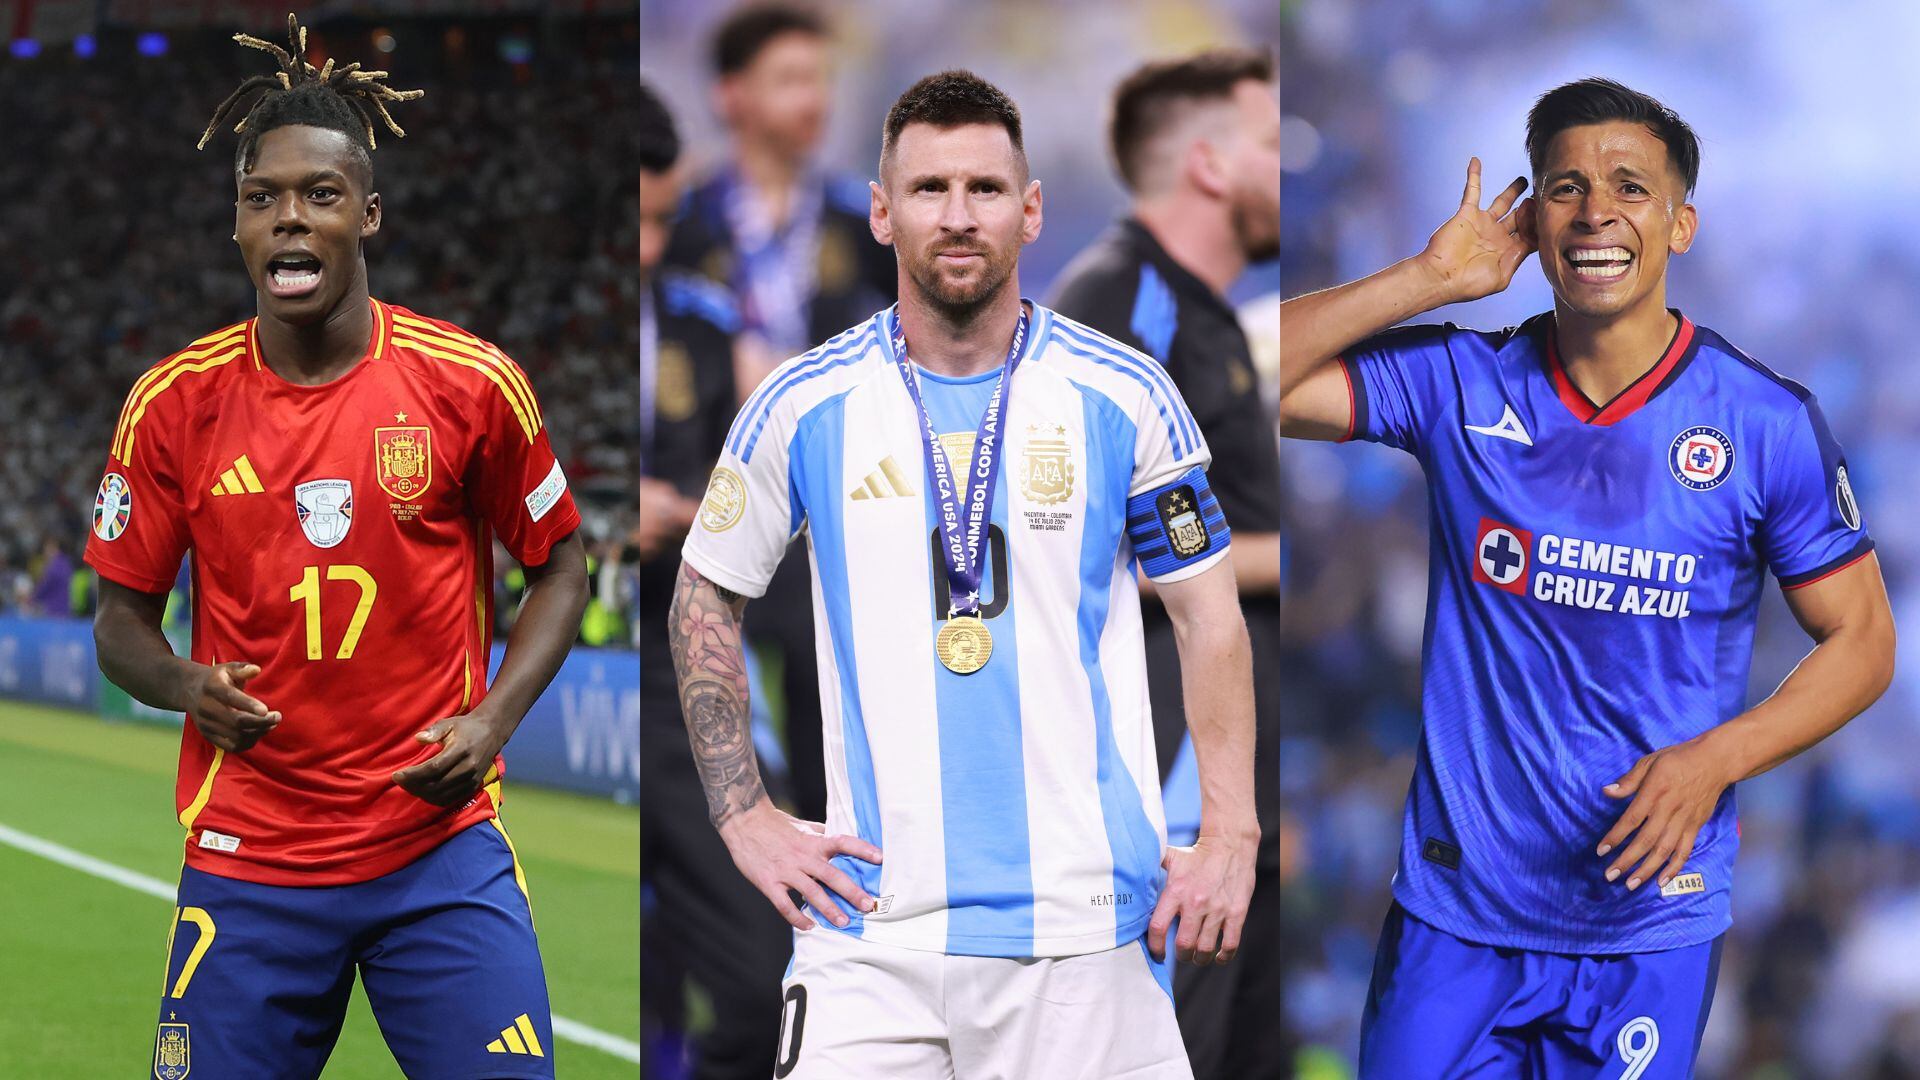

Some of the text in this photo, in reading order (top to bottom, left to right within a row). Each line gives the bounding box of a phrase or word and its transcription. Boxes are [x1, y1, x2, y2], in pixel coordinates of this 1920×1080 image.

[977, 435, 994, 478] COPA
[1675, 431, 1692, 447] CLUB
[1712, 431, 1732, 456] FUTBOL
[928, 429, 968, 574] AMERICA USA 2024
[1677, 472, 1720, 488] CRUZ AZUL
[1538, 534, 1696, 584] CEMENTO
[290, 565, 377, 660] 17
[1534, 571, 1691, 619] CRUZ AZUL
[1679, 877, 1703, 889] 4482
[1617, 1016, 1660, 1080] 9
